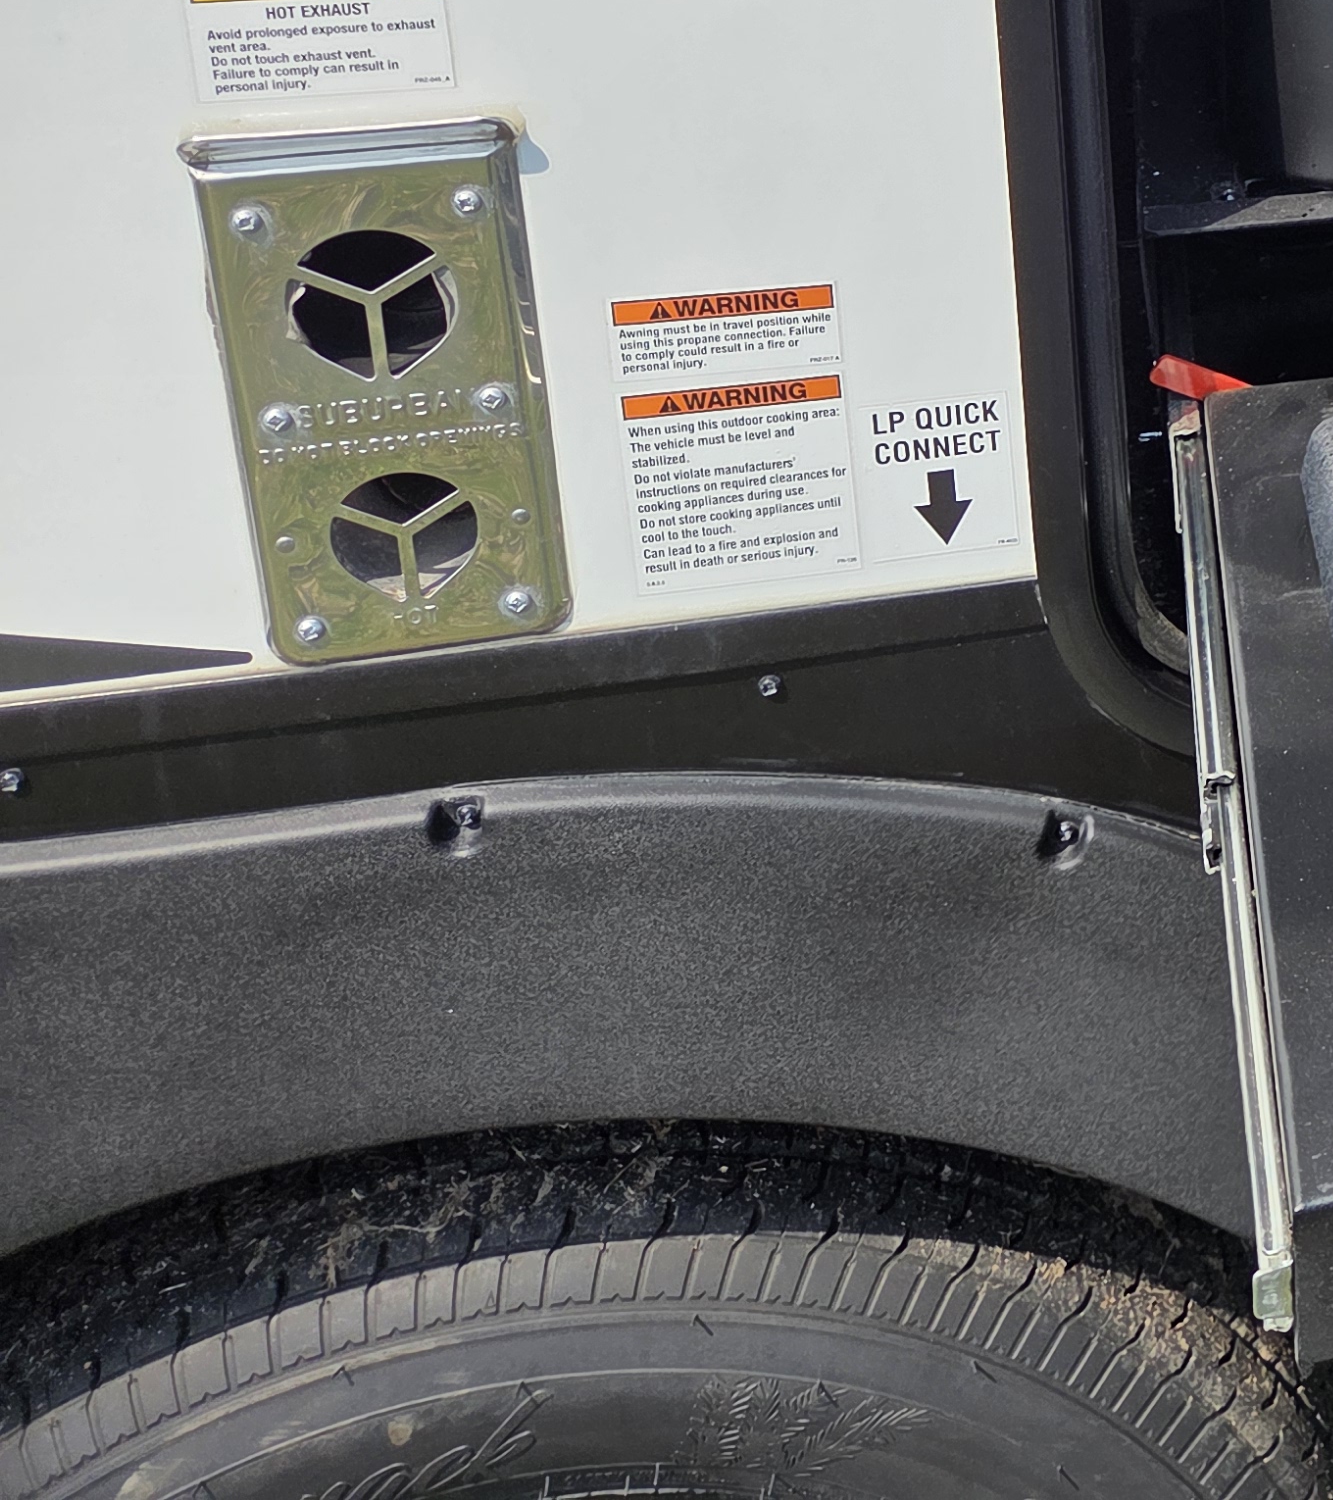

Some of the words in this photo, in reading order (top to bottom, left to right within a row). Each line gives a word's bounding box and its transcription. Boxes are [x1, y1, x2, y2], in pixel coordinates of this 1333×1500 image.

[265, 6, 295, 20] HOT
[301, 2, 369, 18] EXHAUST
[207, 29, 242, 41] Avoid
[245, 25, 308, 40] prolonged
[311, 24, 368, 36] exposure
[370, 21, 384, 32] to
[387, 19, 435, 31] exhaust
[208, 43, 237, 54] vent
[239, 42, 271, 52] area.
[210, 56, 228, 67] Do
[231, 55, 252, 66] not
[254, 53, 290, 65] touch
[293, 50, 342, 63] exhaust
[345, 48, 376, 60] vent.
[212, 69, 256, 80] Failure
[258, 67, 272, 78] to
[275, 65, 319, 77] comply
[323, 64, 346, 74] can
[349, 60, 385, 72] result
[387, 59, 400, 70] in
[215, 80, 269, 95] personal
[272, 79, 311, 92] injury.
[674, 291, 800, 317] WARNING
[619, 328, 660, 339] Awning
[663, 324, 690, 335] must
[693, 323, 707, 333] be
[709, 322, 720, 331] in
[723, 318, 754, 330] travel
[756, 316, 799, 329] position
[802, 312, 831, 323] while
[620, 340, 650, 351] using
[653, 337, 674, 348] this
[676, 335, 721, 347] propane
[724, 329, 786, 342] connection.
[789, 325, 826, 336] Failure
[621, 352, 632, 362] to
[635, 349, 675, 361] comply
[678, 345, 708, 357] could
[710, 343, 742, 354] result
[744, 341, 755, 351] in
[757, 342, 765, 350] a
[767, 339, 785, 349] fire
[787, 339, 799, 348] or
[622, 361, 670, 375] personal
[672, 359, 707, 370] injury.
[683, 383, 808, 410] WARNING
[627, 426, 662, 438] When
[664, 423, 695, 434] using
[697, 419, 718, 431] this
[721, 416, 763, 428] outdoor
[766, 411, 809, 424] cooking
[811, 408, 840, 419] area:
[872, 411, 905, 435] LP
[915, 400, 998, 430] QUICK
[629, 442, 651, 453] The
[654, 437, 694, 451] vehicle
[697, 434, 725, 446] must
[727, 432, 742, 443] be
[744, 428, 772, 441] level
[774, 426, 795, 438] and
[875, 430, 999, 464] CONNECT
[632, 453, 689, 469] stabilized.
[633, 474, 650, 485] Do
[653, 471, 671, 483] not
[673, 468, 711, 480] violate
[714, 457, 795, 476] manufacturers'
[636, 484, 701, 499] instructions
[703, 482, 718, 492] on
[720, 475, 767, 490] required
[769, 470, 829, 484] clearances
[831, 467, 847, 477] for
[637, 500, 681, 513] cooking
[684, 494, 744, 509] appliances
[747, 489, 782, 501] during
[785, 486, 808, 497] use.
[639, 518, 656, 530] Do
[658, 516, 676, 527] not
[678, 514, 707, 525] store
[709, 509, 753, 521] cooking
[755, 502, 814, 517] appliances
[817, 496, 841, 509] until
[641, 531, 665, 544] cool
[667, 530, 679, 541] to
[681, 528, 699, 539] the
[701, 524, 736, 537] touch.
[643, 548, 666, 560] Can
[668, 544, 692, 557] lead
[694, 543, 706, 554] to
[708, 543, 716, 552] a
[718, 540, 737, 551] fire
[740, 536, 760, 548] and
[763, 531, 816, 546] explosion
[818, 527, 839, 539] and
[645, 560, 677, 574] result
[679, 559, 691, 570] in
[693, 555, 724, 568] death
[727, 555, 739, 564] or
[741, 550, 781, 562] serious
[784, 546, 818, 558] injury.
